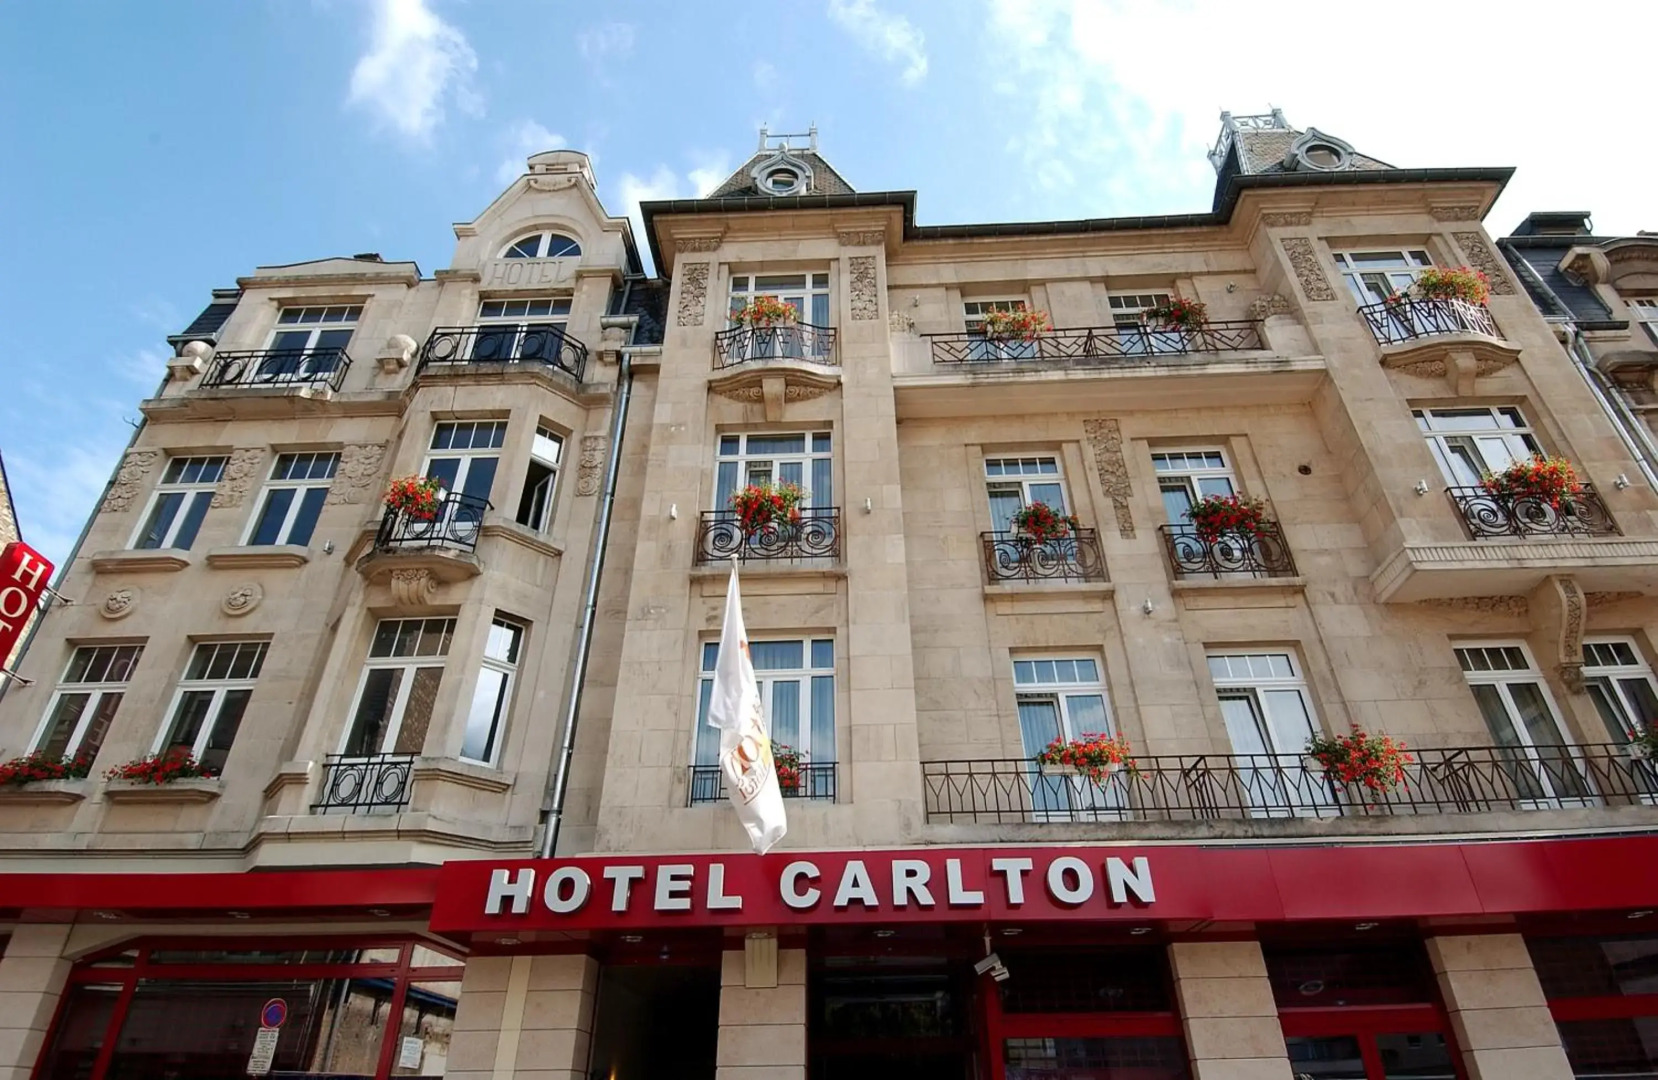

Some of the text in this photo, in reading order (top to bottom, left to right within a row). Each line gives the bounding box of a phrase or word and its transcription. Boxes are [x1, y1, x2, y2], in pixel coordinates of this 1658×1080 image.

[488, 261, 568, 285] HOTEL
[485, 856, 1157, 915] HOTEL CARLTON
